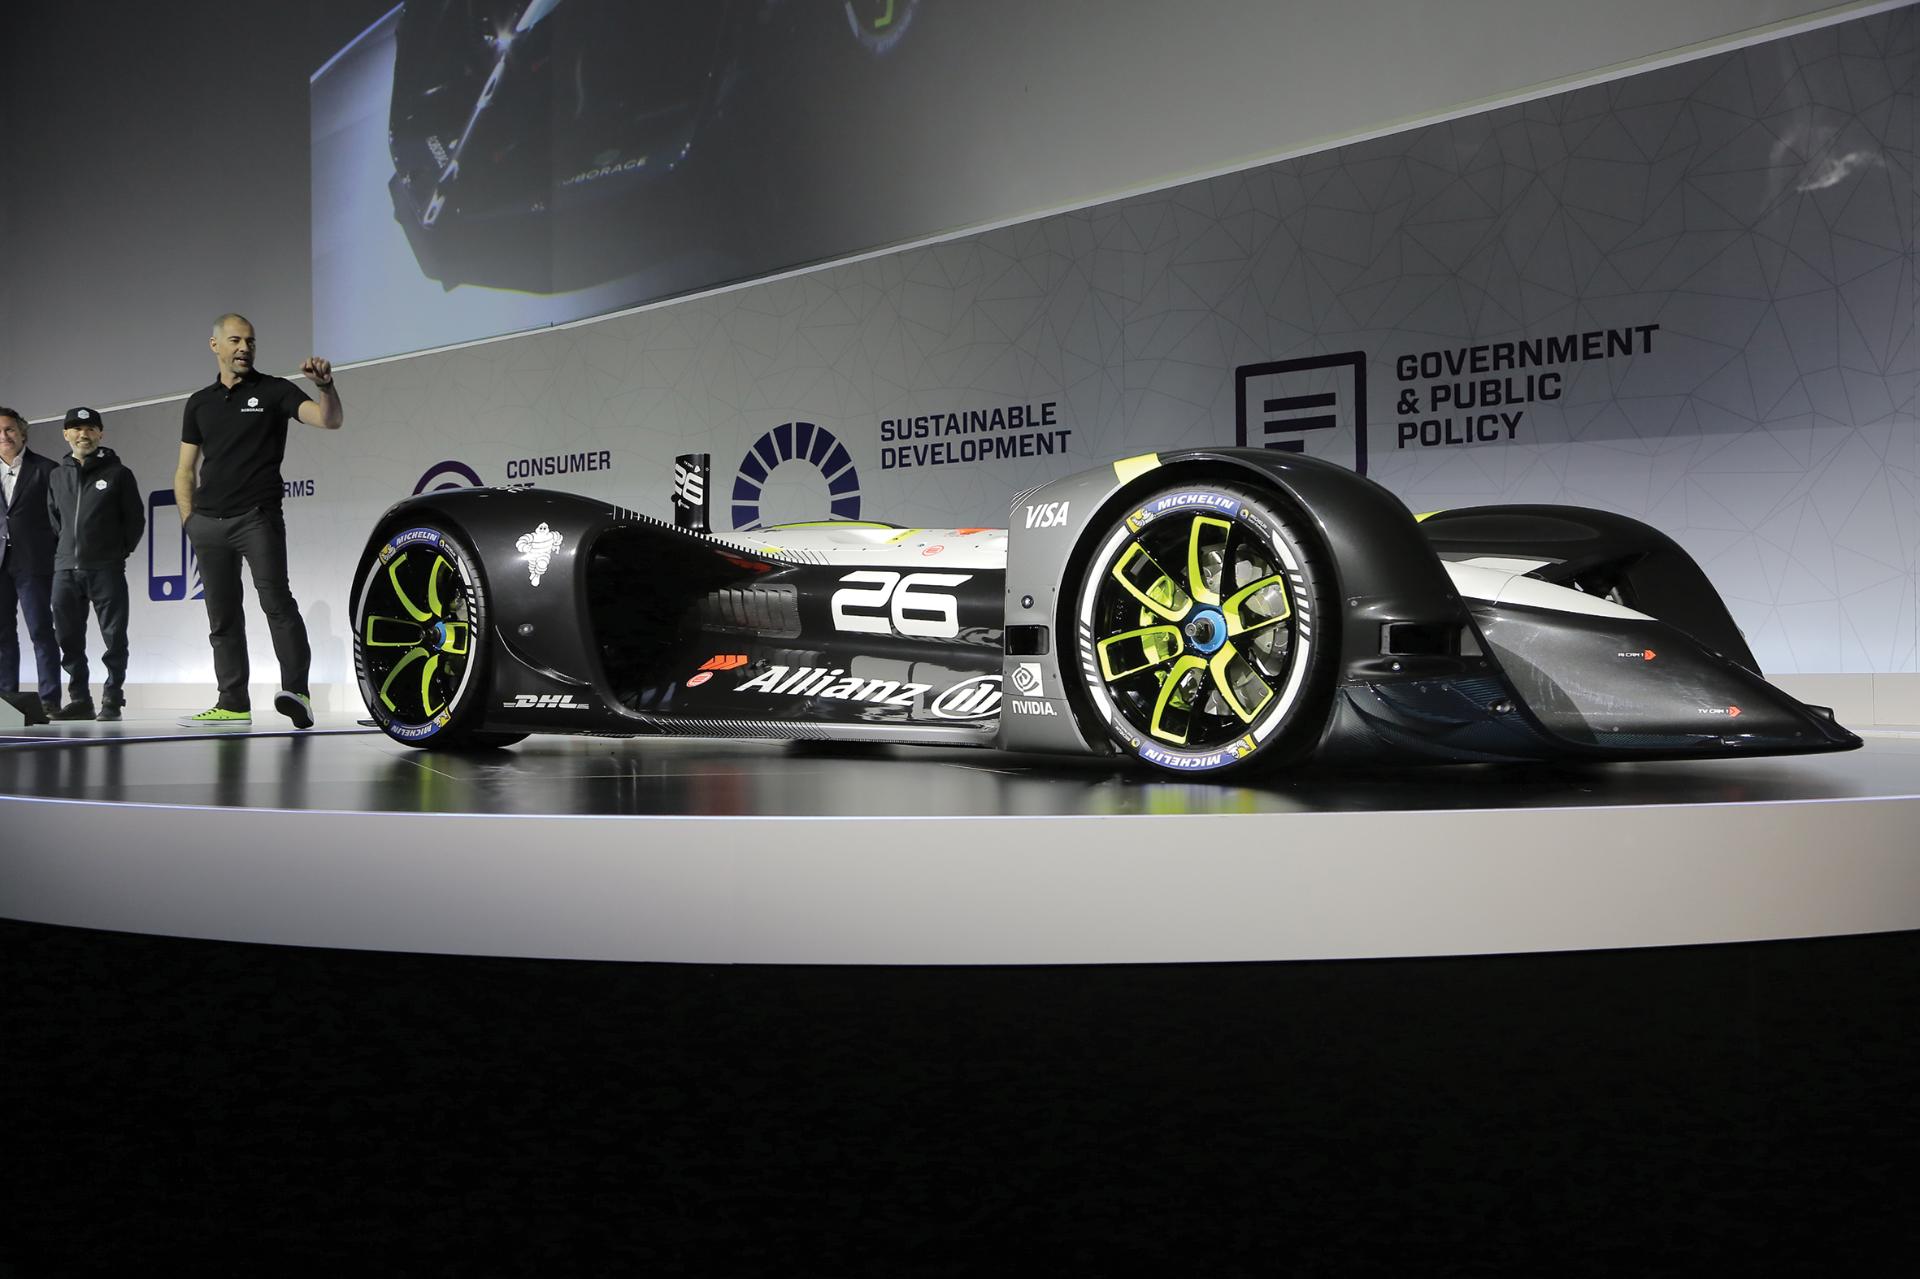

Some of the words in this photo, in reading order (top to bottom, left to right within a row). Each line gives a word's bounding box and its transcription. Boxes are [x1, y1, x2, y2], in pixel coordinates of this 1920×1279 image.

[1396, 324, 1660, 381] GOVERNMENT
[1397, 388, 1420, 415] &
[1430, 372, 1562, 412] PUBLIC
[881, 402, 1056, 442] SUSTAINABLE
[1398, 411, 1524, 449] POLICY
[506, 450, 611, 479] CONSUMER
[881, 430, 1072, 470] DEVELOPMENT
[283, 479, 315, 498] RMS
[1157, 493, 1235, 511] MICHELIN
[1025, 501, 1070, 529] VISA
[396, 530, 438, 546] MICHELIN
[831, 570, 974, 638] 26
[733, 655, 933, 706] Allianz
[515, 694, 578, 709] DHL
[391, 724, 433, 737] MICHELIN
[1145, 748, 1222, 768] MICHELIN
